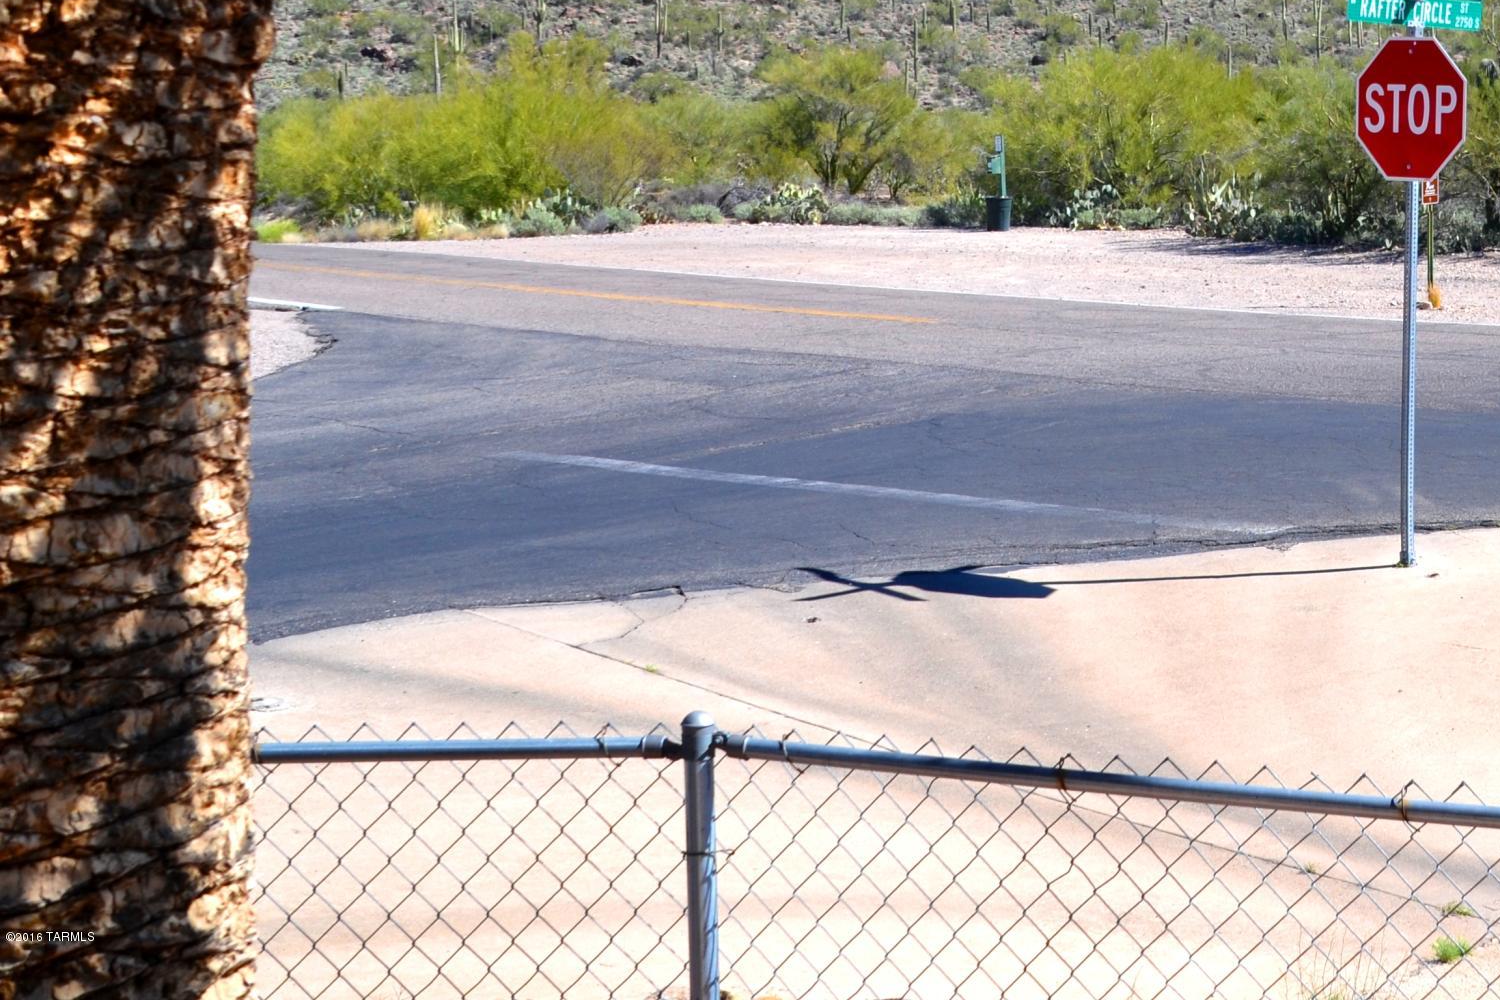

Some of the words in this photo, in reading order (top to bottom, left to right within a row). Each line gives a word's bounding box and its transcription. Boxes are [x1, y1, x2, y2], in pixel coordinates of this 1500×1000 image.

[1413, 1, 1452, 25] CIRCLE
[1460, 3, 1469, 14] ST
[1455, 16, 1473, 28] 2750
[1474, 17, 1480, 29] S
[1364, 83, 1458, 135] STOP
